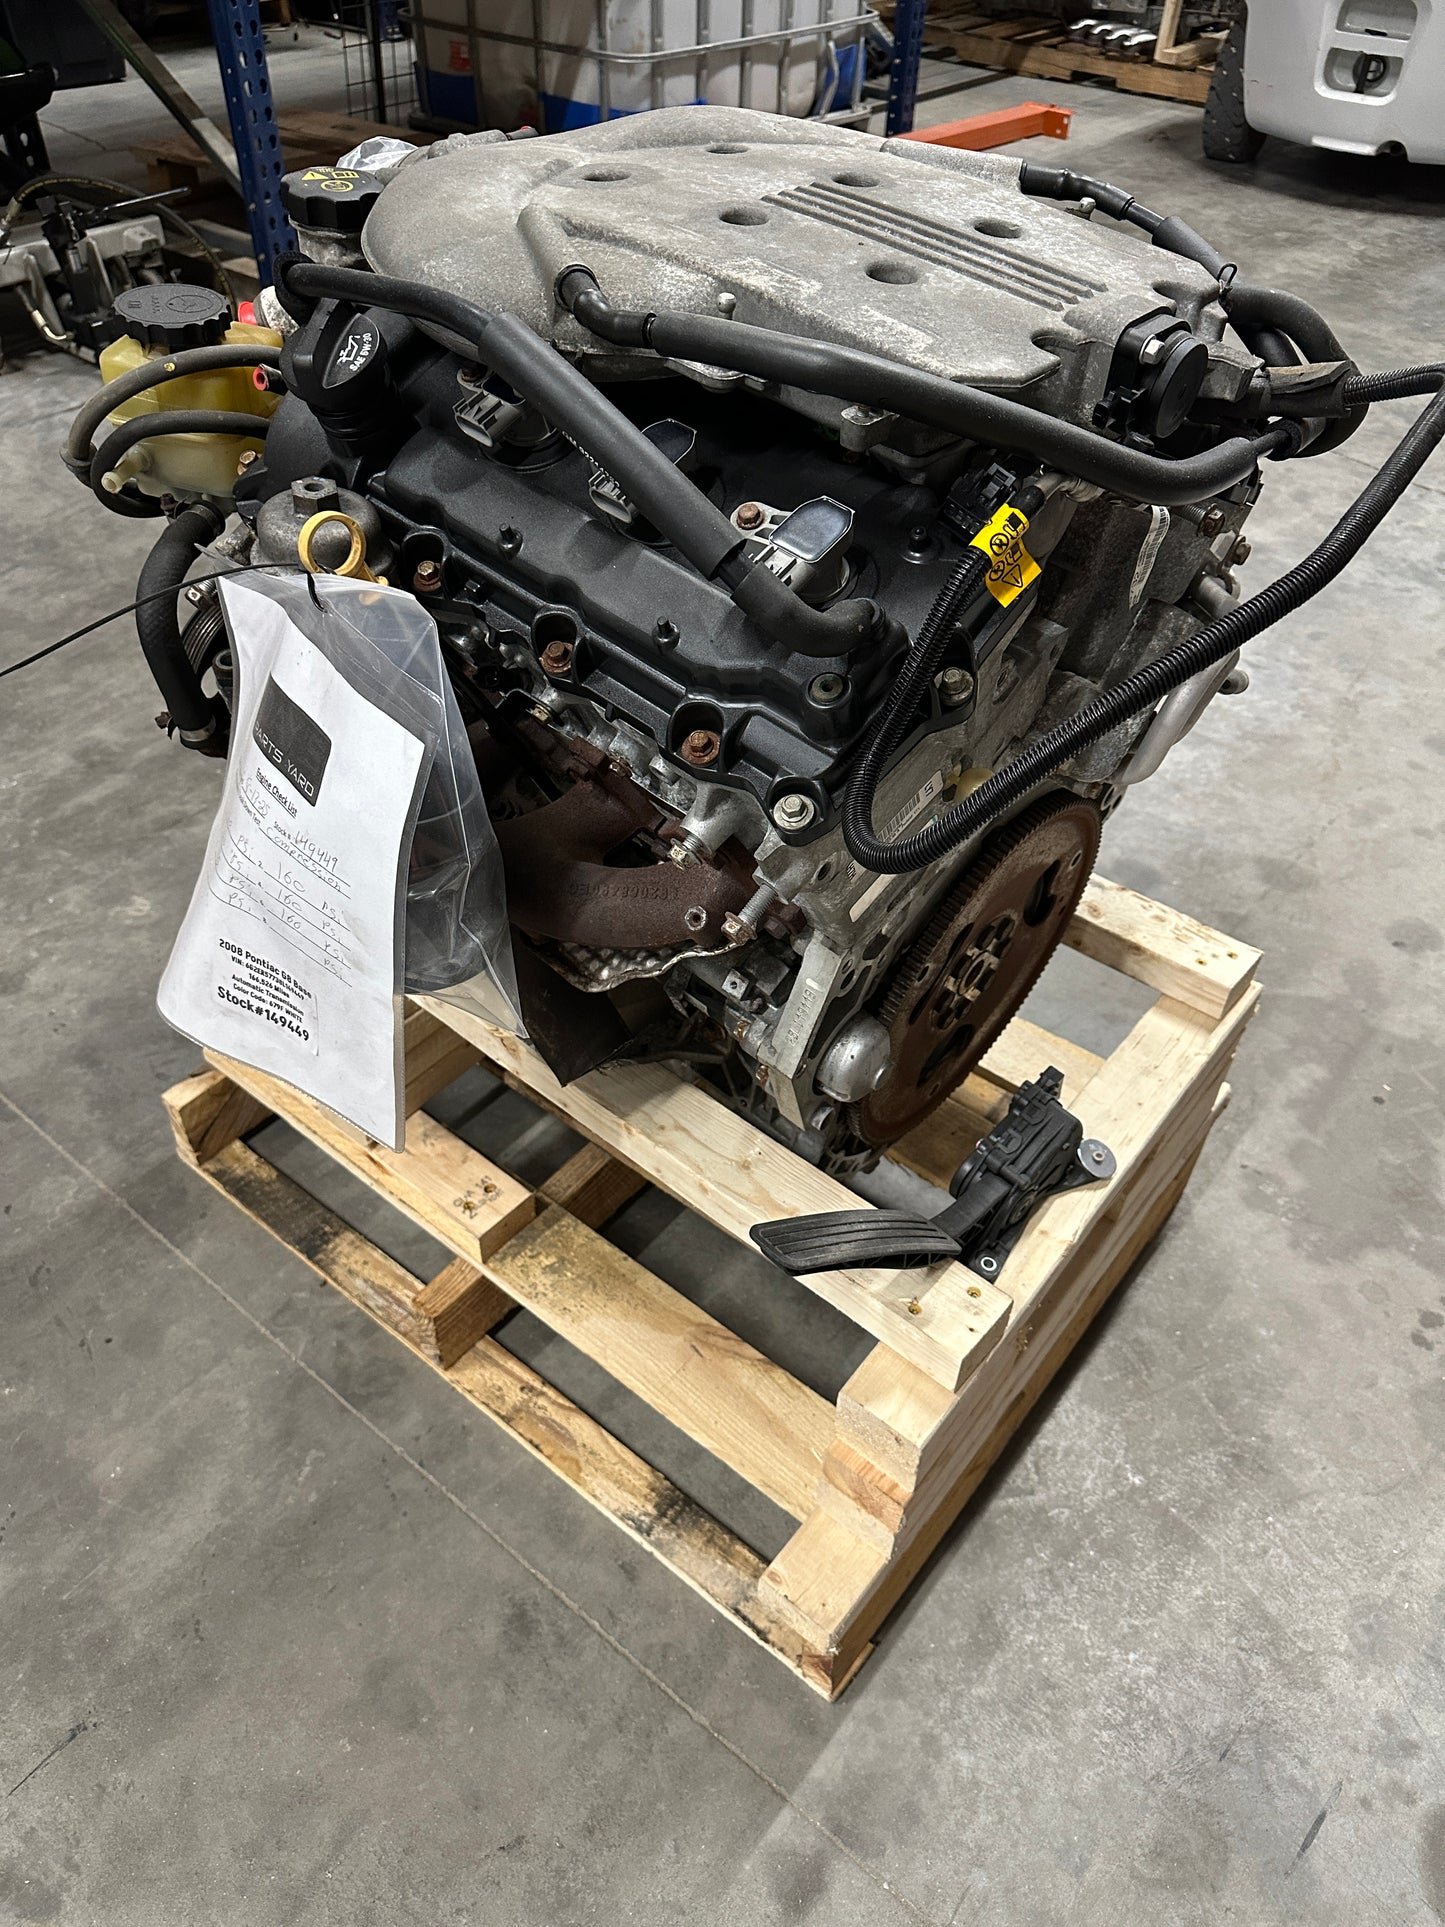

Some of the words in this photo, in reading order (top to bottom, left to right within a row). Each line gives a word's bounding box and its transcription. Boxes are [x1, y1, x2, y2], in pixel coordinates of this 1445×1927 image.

[349, 355, 366, 371] SAE
[360, 332, 373, 356] 5W-30
[286, 758, 315, 797] YARD
[271, 783, 289, 808] Check
[287, 799, 298, 817] List
[294, 830, 339, 873] 149449
[278, 861, 306, 893] 160
[277, 888, 303, 912] 160
[280, 908, 302, 930] 160
[219, 938, 243, 957] 2008
[245, 950, 280, 976] Pontiac
[281, 970, 292, 984] G8
[293, 979, 312, 999] Base
[231, 955, 245, 967] VIN:
[231, 973, 265, 994] Automatic
[265, 989, 305, 1017] Transmission
[233, 983, 250, 995] Color
[250, 991, 268, 1005] Code:
[285, 1007, 303, 1024] WHITE
[248, 972, 274, 990] 166,526
[273, 984, 290, 999] Miles
[217, 985, 310, 1042] Stock#149449
